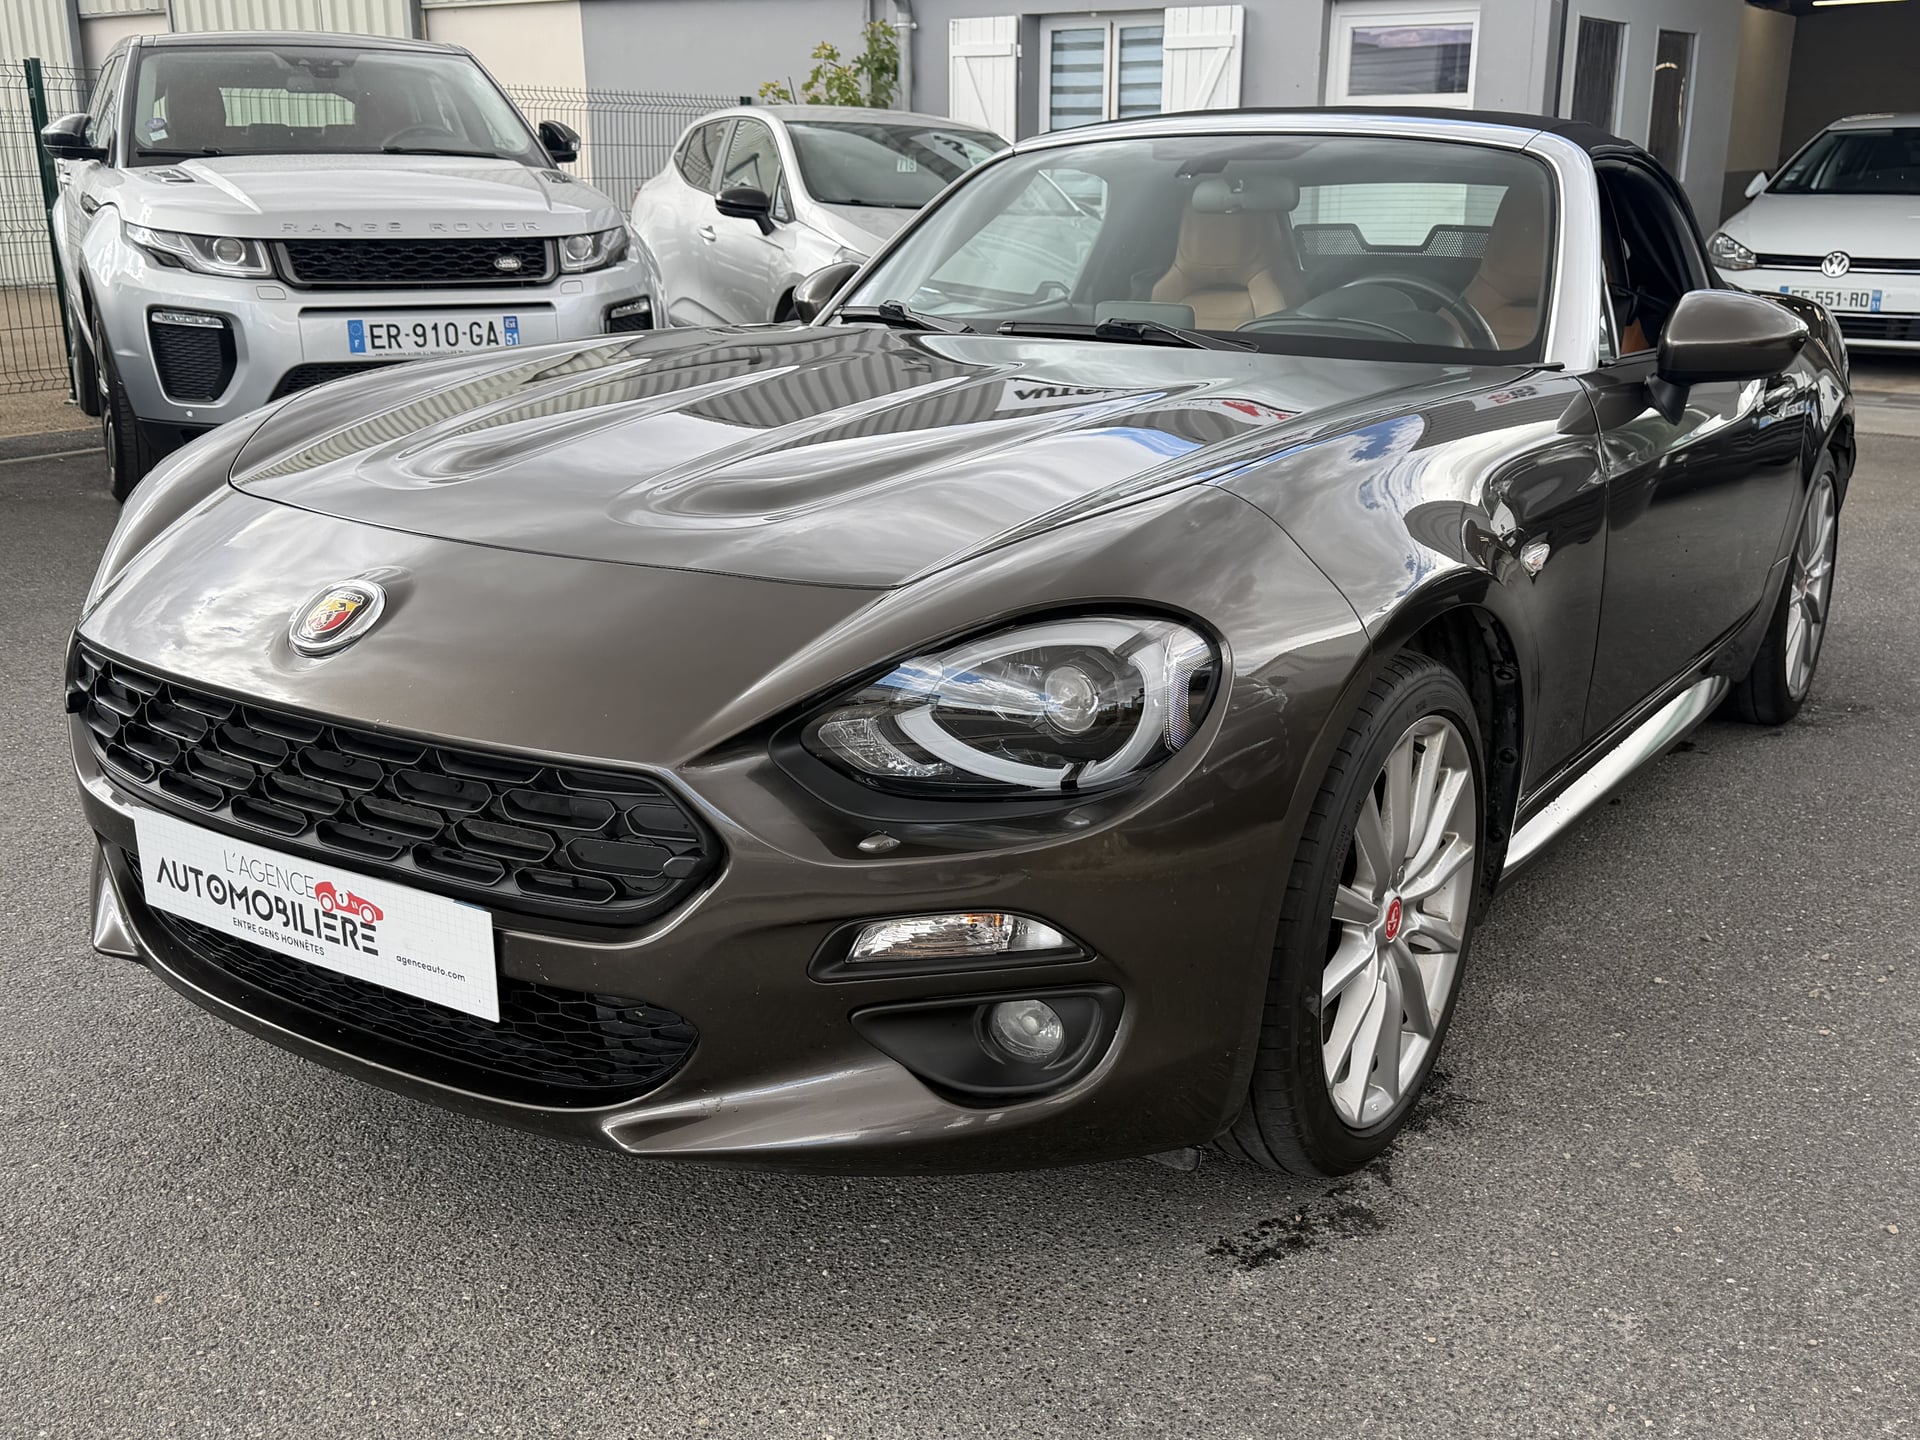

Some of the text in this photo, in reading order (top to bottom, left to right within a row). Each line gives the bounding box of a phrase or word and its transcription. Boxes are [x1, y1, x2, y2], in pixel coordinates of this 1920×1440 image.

[281, 221, 541, 232] RANGE ROVER
[369, 321, 499, 350] ER-910-GA
[506, 332, 518, 346] 51
[223, 849, 316, 900] L'AGENCE
[232, 916, 325, 957] ENTRE GENS HONNÊTES
[396, 955, 466, 982] agenceauto.com
